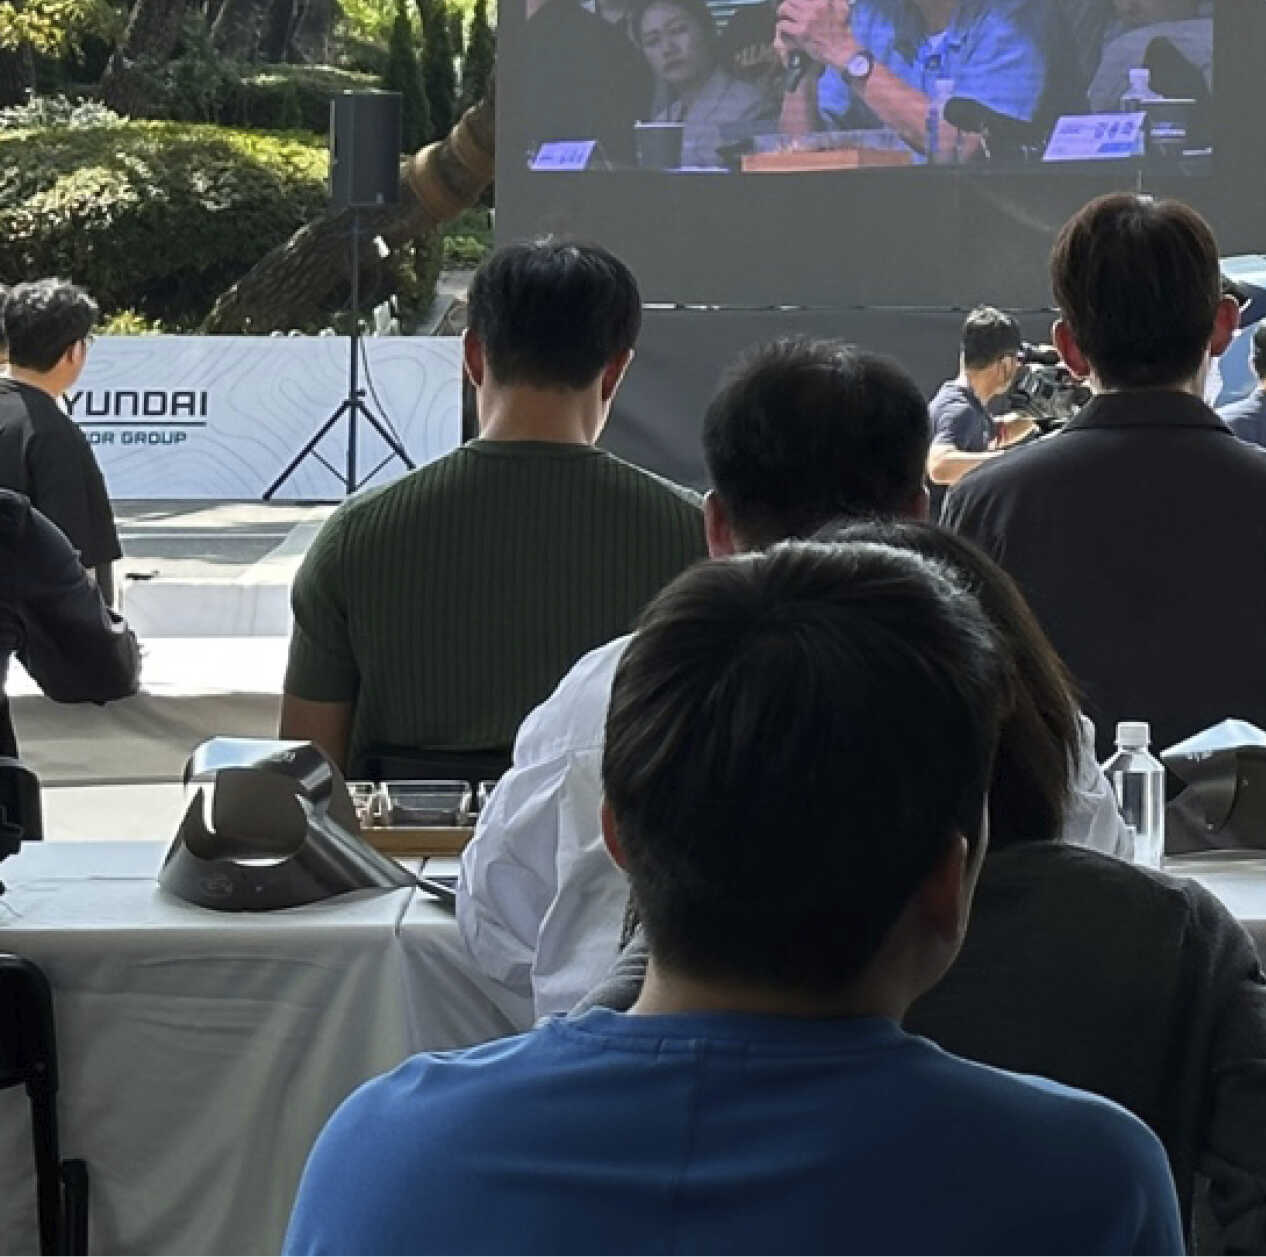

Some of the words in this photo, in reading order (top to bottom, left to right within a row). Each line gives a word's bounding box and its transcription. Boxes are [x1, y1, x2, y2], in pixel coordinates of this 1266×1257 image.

[62, 390, 208, 416] YUNDAI
[90, 431, 115, 444] OR
[120, 431, 187, 444] GROUP
